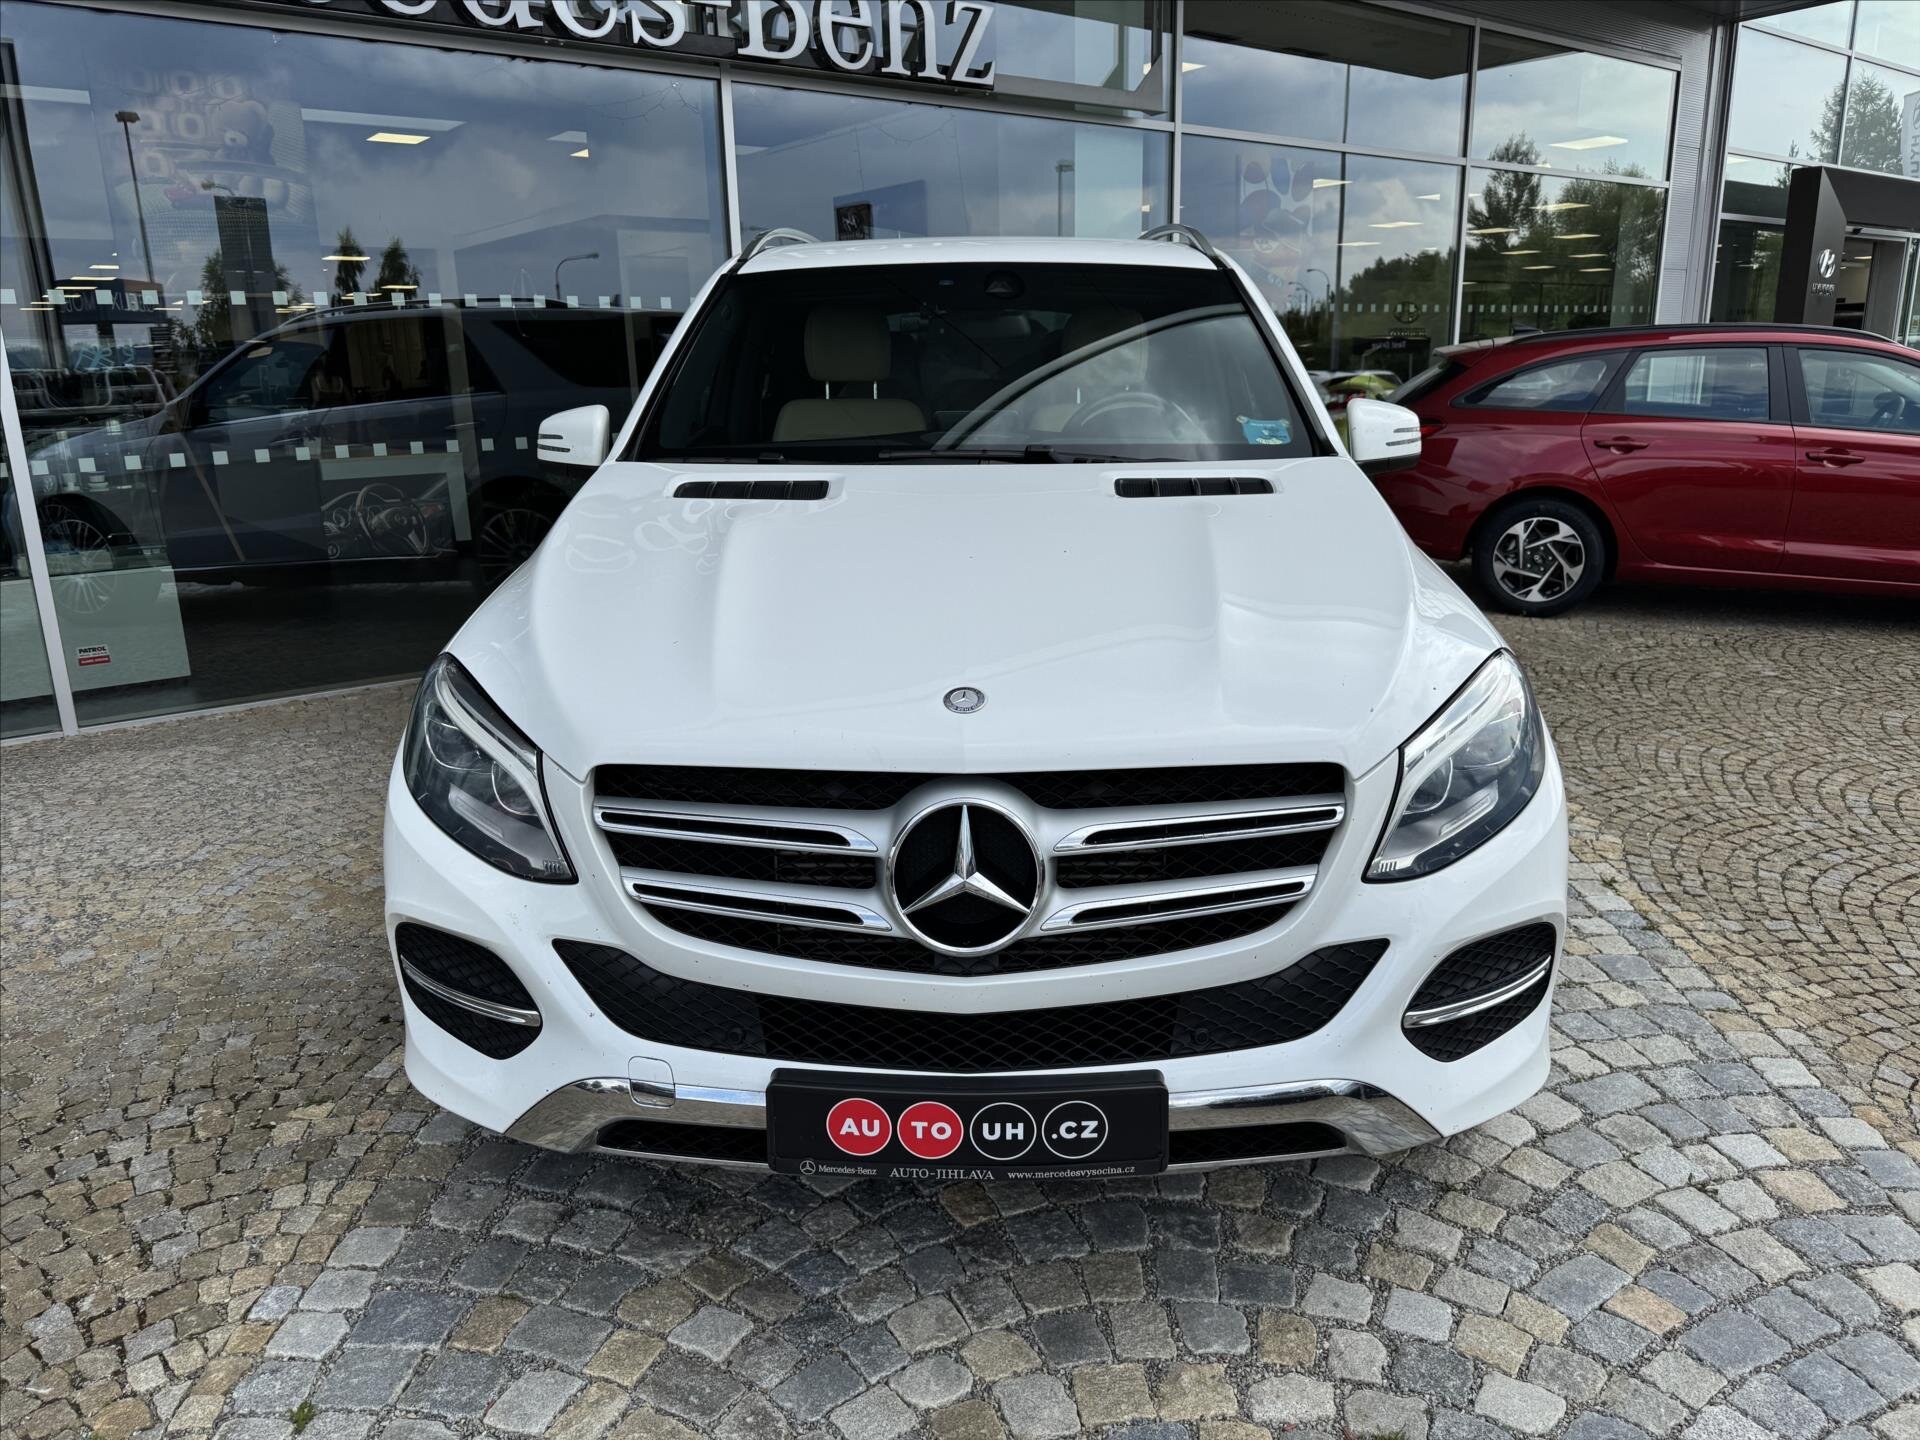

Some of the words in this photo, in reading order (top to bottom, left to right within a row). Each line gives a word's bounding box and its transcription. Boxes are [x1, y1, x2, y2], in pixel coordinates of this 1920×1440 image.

[79, 646, 106, 654] PATROL
[839, 1117, 880, 1137] AU
[911, 1121, 952, 1140] TO
[982, 1122, 1024, 1141] UH
[1051, 1120, 1099, 1140] .CZ
[818, 1164, 878, 1176] Mercedes-Benz
[890, 1167, 995, 1180] AUTO-JIHLAVA
[1007, 1165, 1136, 1180] www.mercedesvysocina.cz
